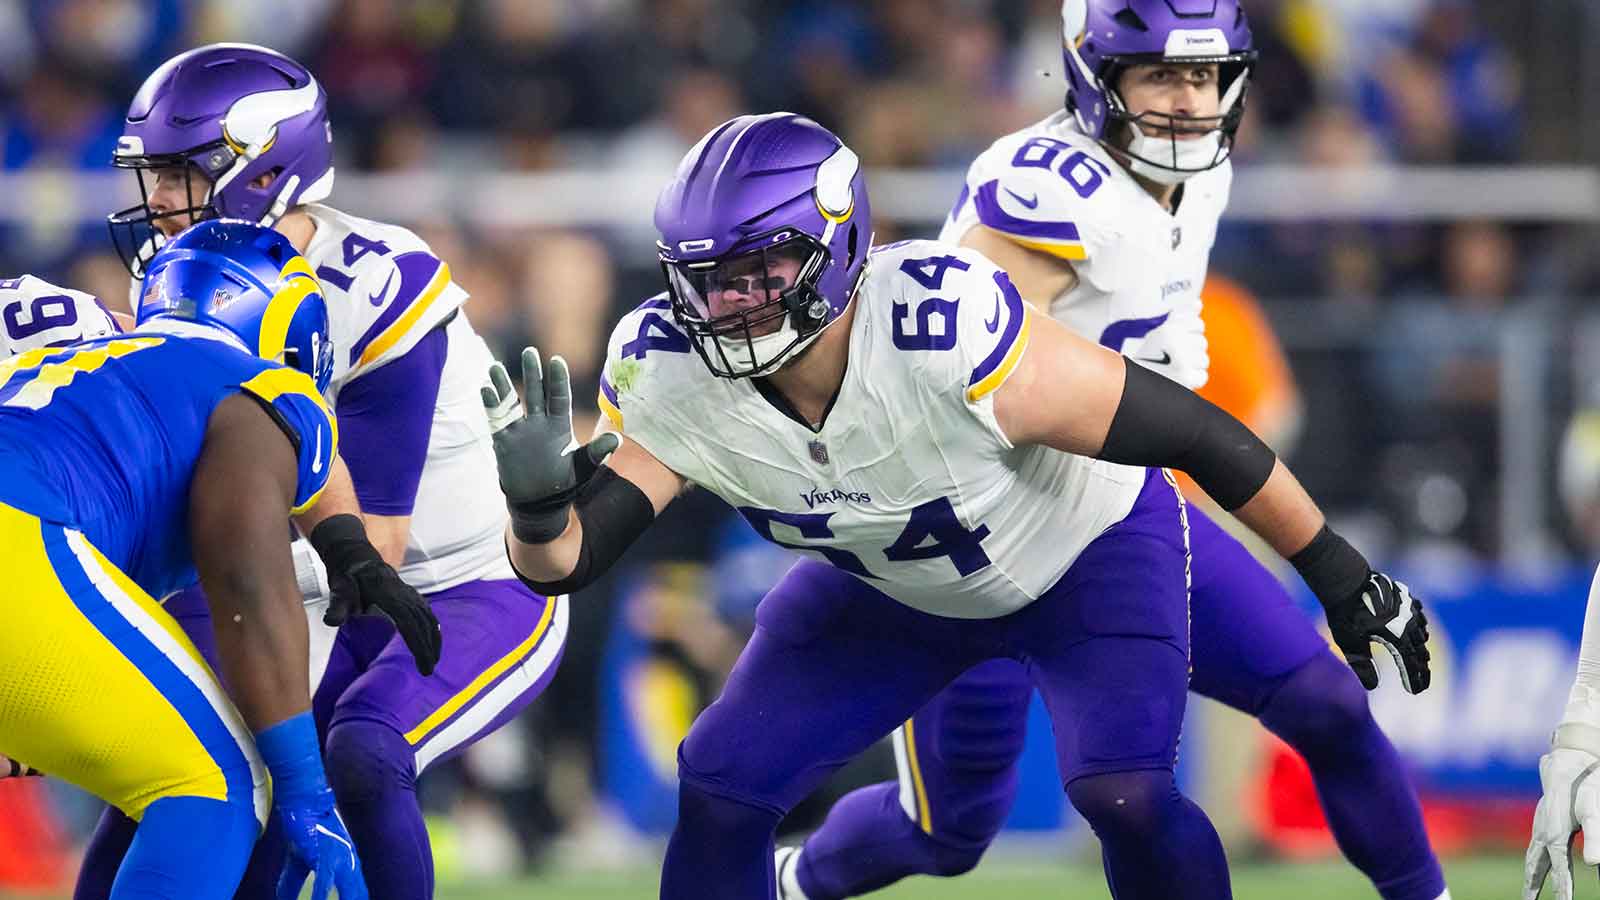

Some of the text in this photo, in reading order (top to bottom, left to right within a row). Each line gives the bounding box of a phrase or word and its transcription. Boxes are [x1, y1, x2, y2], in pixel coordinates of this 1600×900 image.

[1011, 137, 1111, 198] 86
[317, 231, 392, 293] 14
[892, 254, 972, 351] 64
[800, 486, 872, 509] VIKINGS
[736, 495, 992, 581] 64
